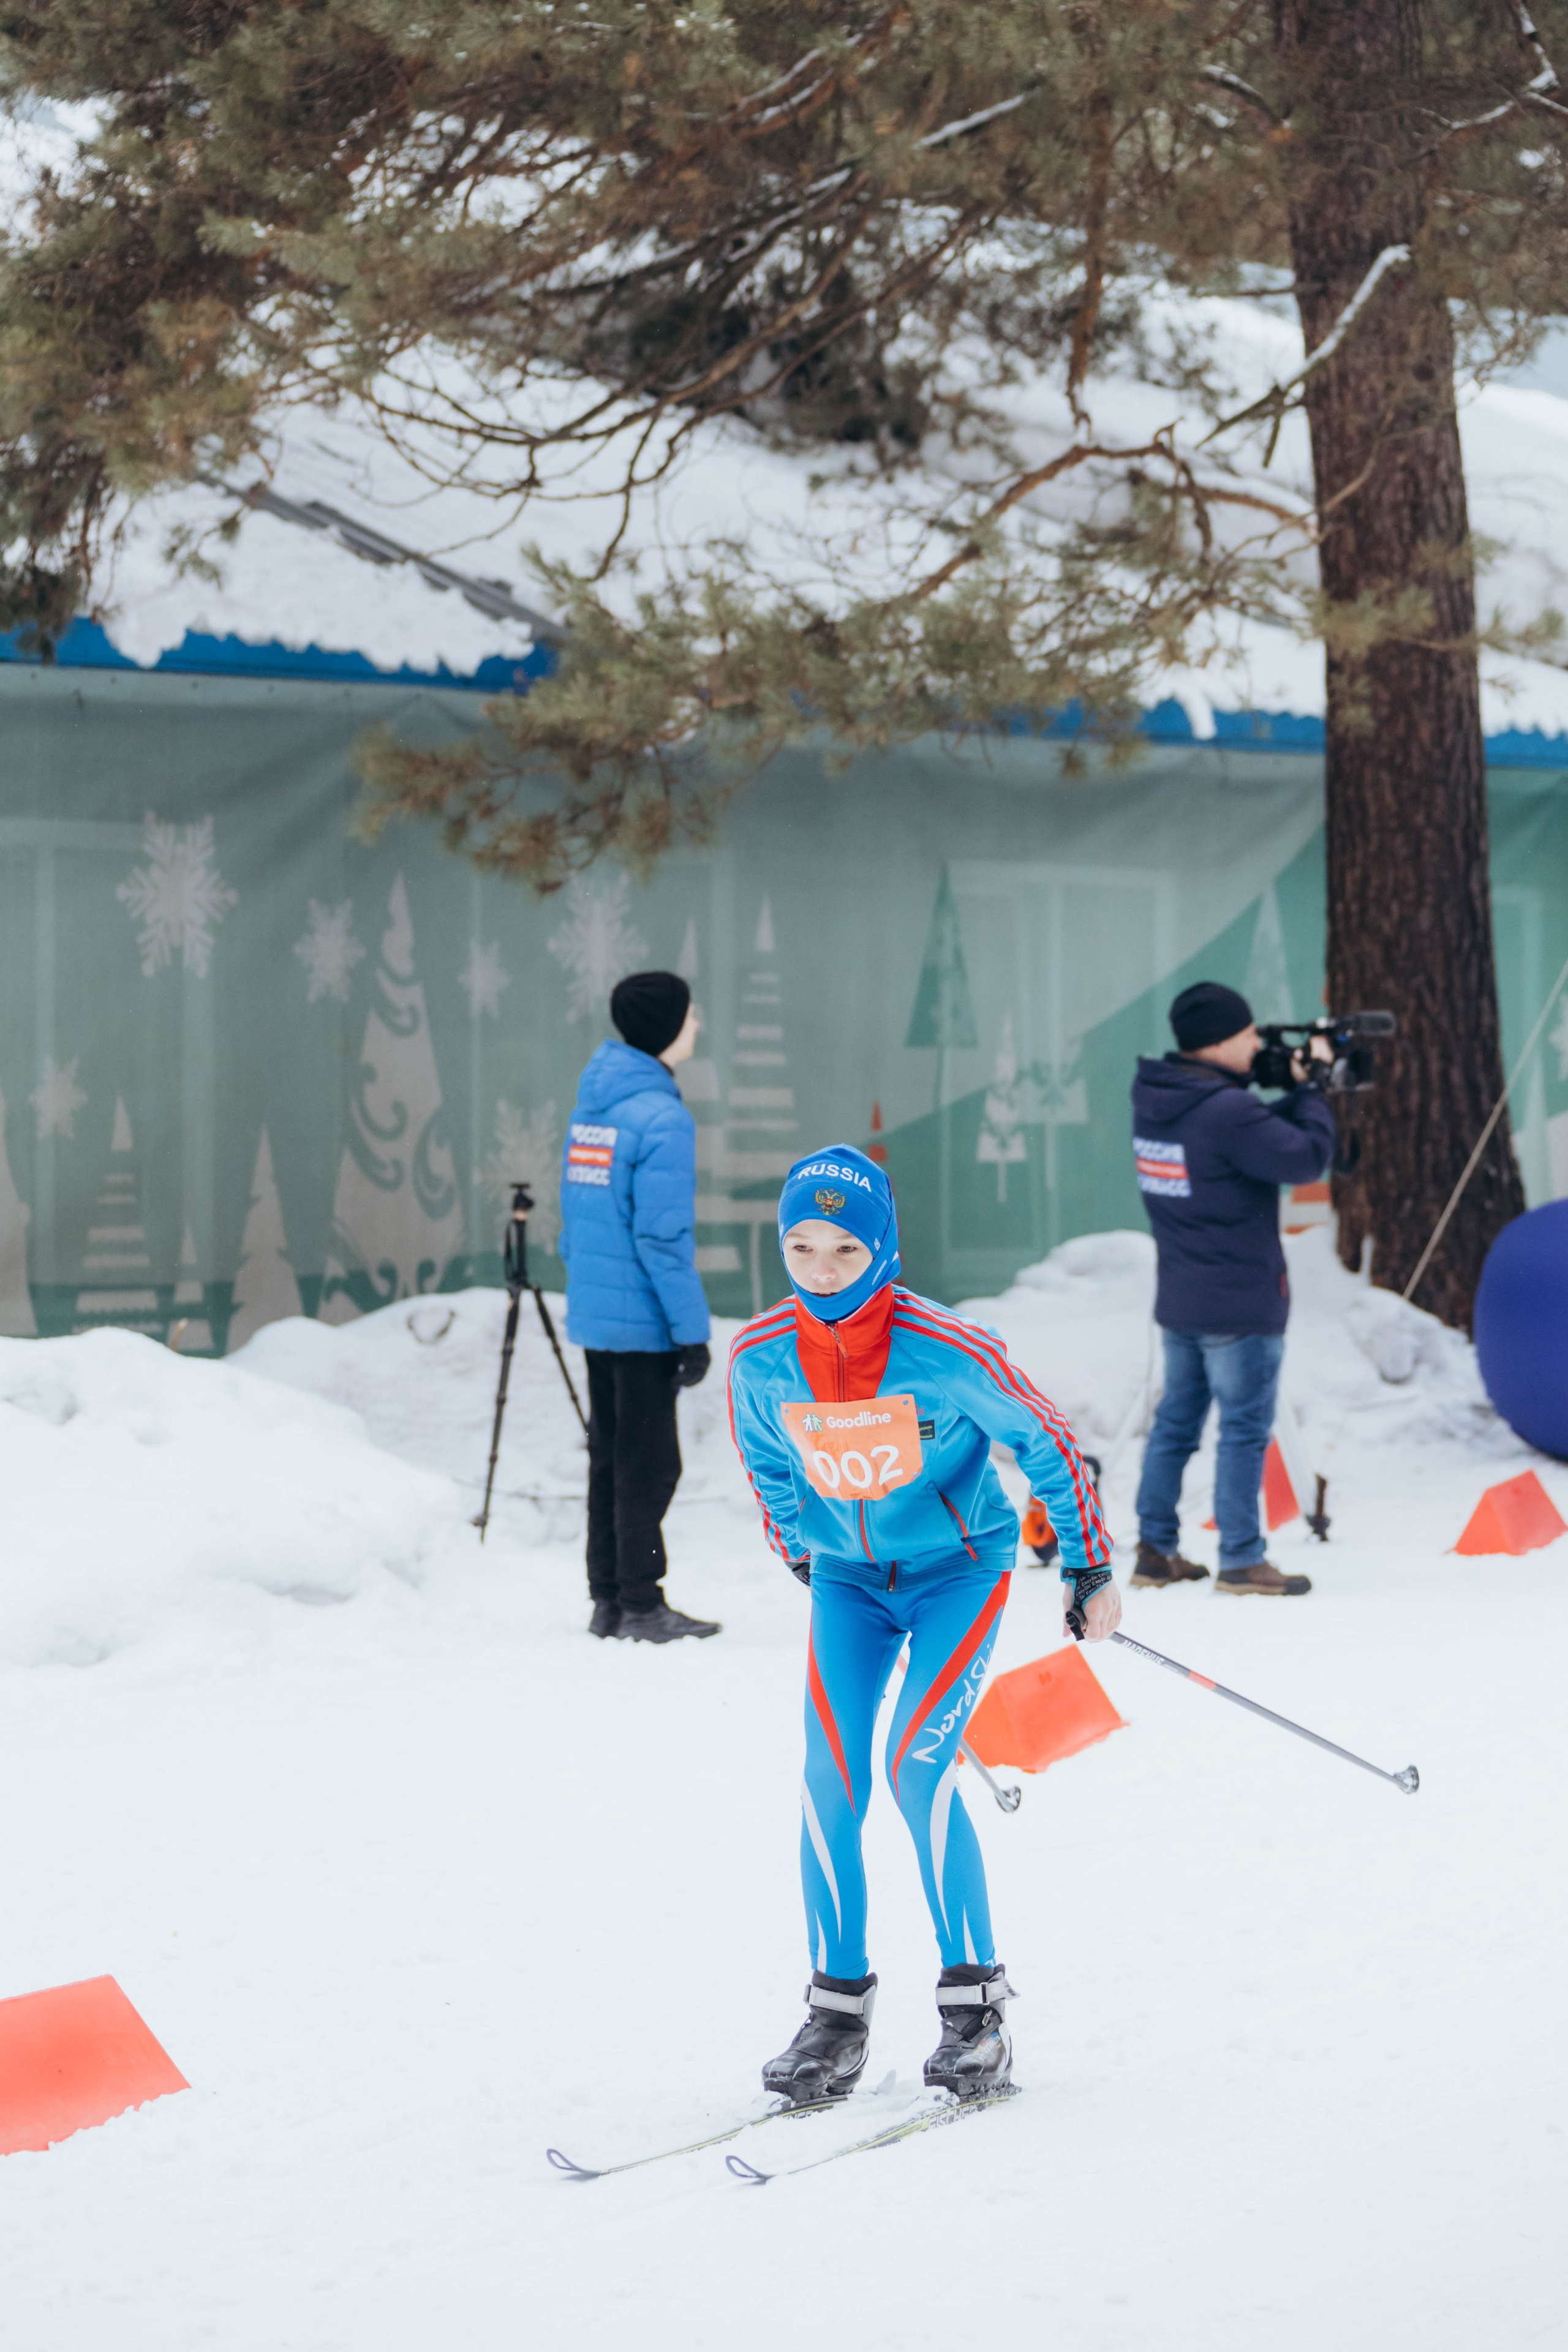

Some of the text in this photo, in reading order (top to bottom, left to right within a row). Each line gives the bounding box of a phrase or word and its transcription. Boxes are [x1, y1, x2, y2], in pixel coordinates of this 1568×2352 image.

[798, 1164, 872, 1193] RUSSIA
[826, 1411, 891, 1428] Goodline
[812, 1445, 903, 1489] 002
